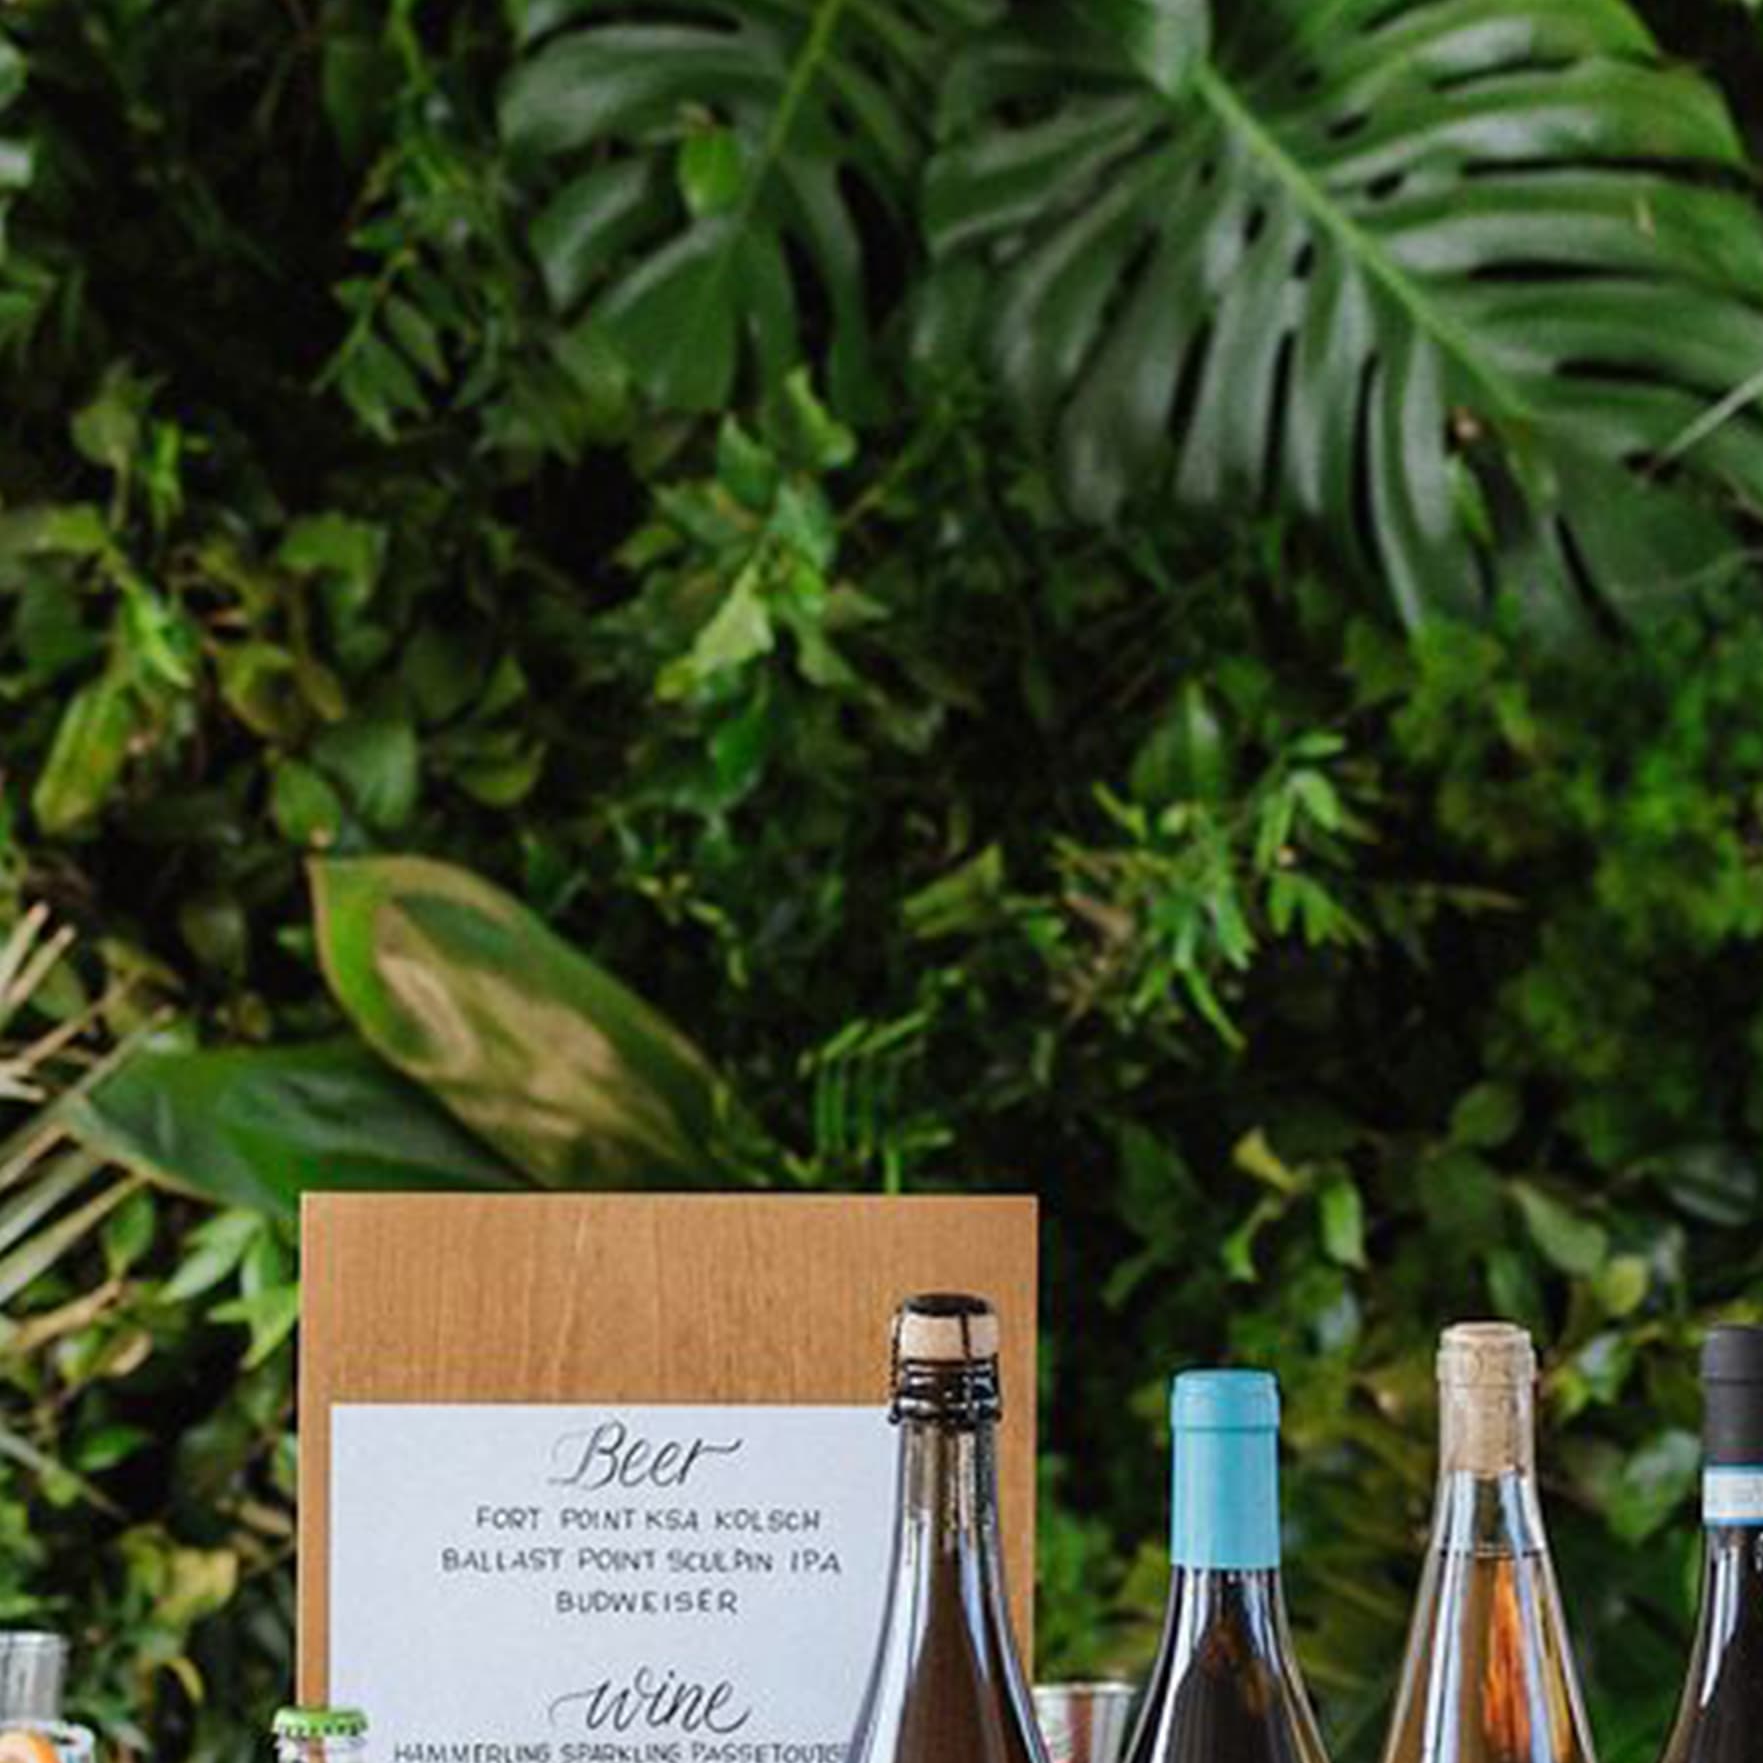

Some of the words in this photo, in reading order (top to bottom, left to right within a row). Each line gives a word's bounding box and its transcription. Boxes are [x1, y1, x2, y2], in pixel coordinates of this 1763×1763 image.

[547, 1420, 743, 1490] Beer
[476, 1506, 541, 1531] FORT
[560, 1506, 636, 1531] POINT
[645, 1507, 699, 1532] KSA
[713, 1507, 822, 1532] KOLSCH
[441, 1547, 564, 1574] BALLAST
[577, 1548, 657, 1572] POINT
[667, 1547, 774, 1574] SCULPIN
[790, 1548, 843, 1574] IPA
[555, 1590, 739, 1615] BUDWEISER
